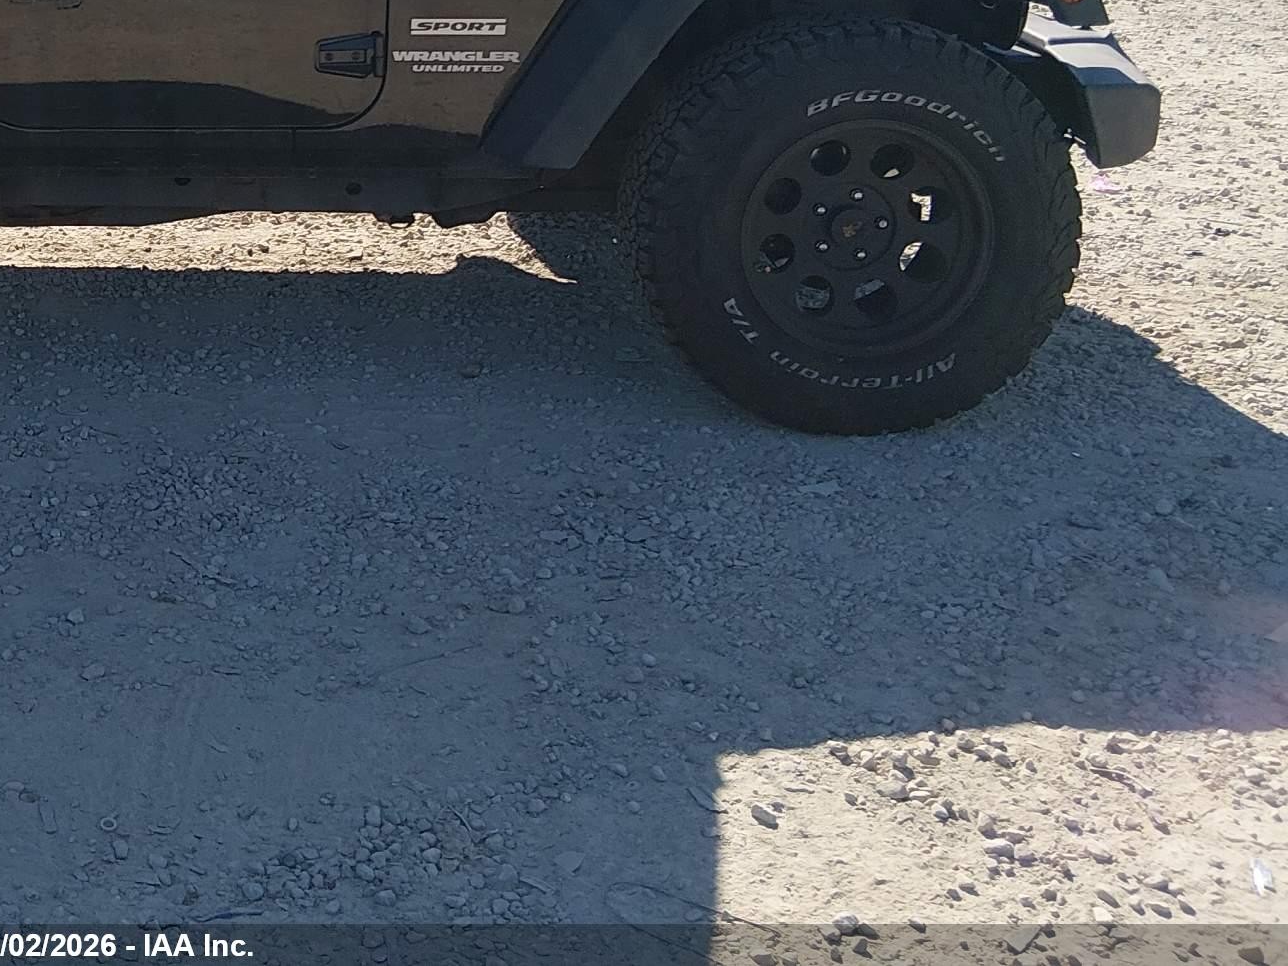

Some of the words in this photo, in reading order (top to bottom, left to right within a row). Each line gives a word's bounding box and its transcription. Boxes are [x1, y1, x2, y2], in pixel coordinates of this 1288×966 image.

[411, 22, 507, 32] SPORT
[392, 51, 520, 63] WRANGLER
[412, 64, 505, 73] UNLIMITED
[807, 89, 1006, 162] BFGoodrich
[723, 297, 760, 344] T/A
[770, 352, 956, 389] All-Terrain
